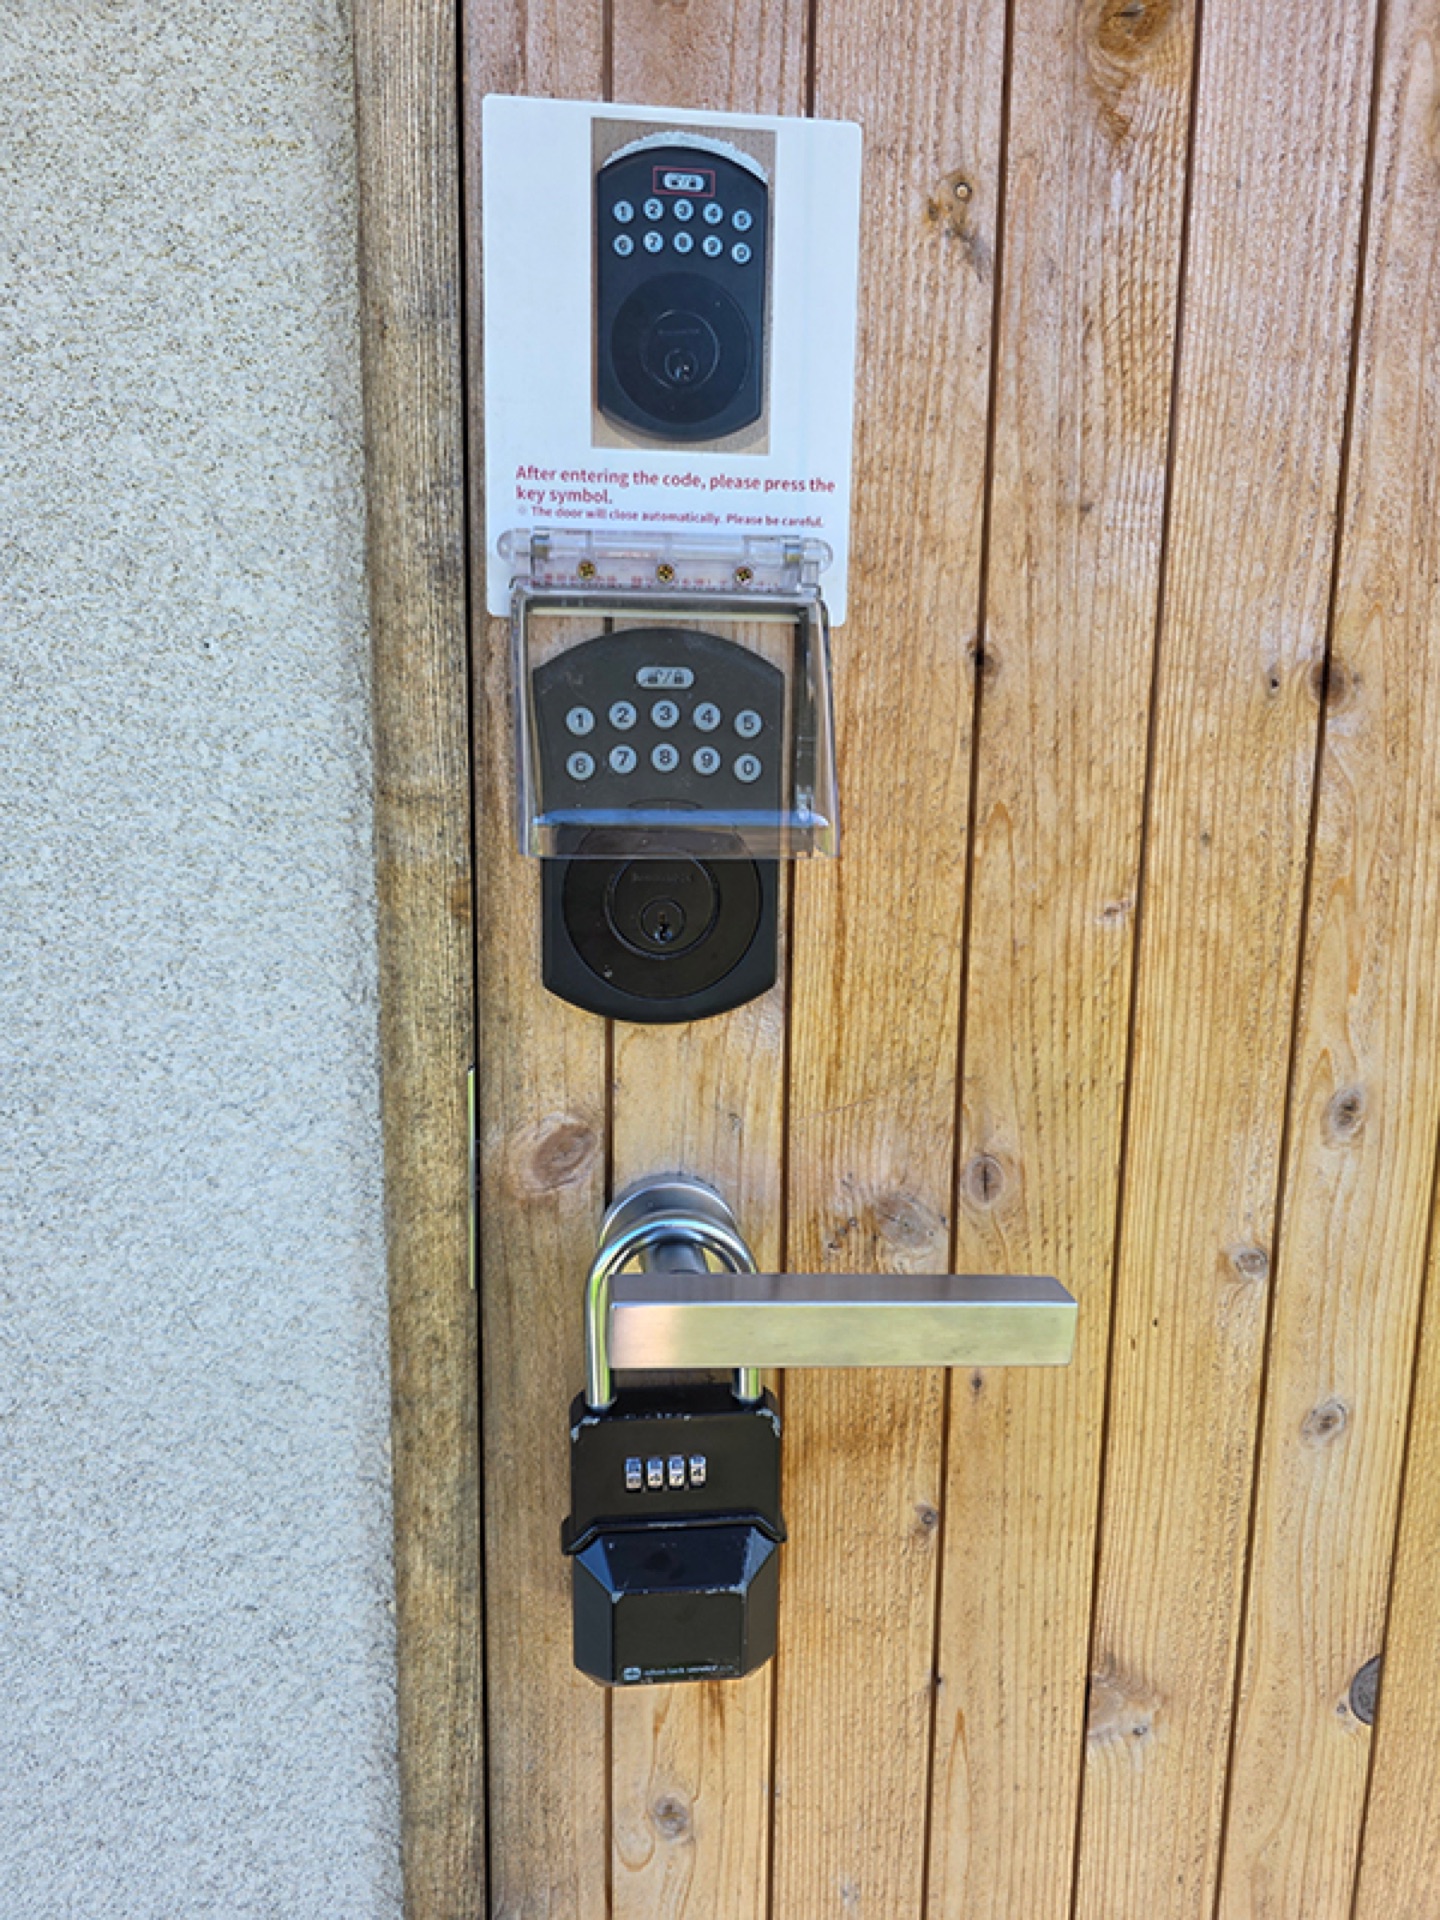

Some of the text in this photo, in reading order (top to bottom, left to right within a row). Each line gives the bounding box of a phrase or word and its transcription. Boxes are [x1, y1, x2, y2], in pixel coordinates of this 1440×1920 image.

[516, 465, 835, 493] After entering the code, please press the
[516, 485, 613, 504] key symbol.
[531, 506, 824, 528] The door will close automatically. Please be careful.
[575, 705, 754, 730] 1 2 3 4 5
[574, 749, 754, 776] 6 7 8 9 0
